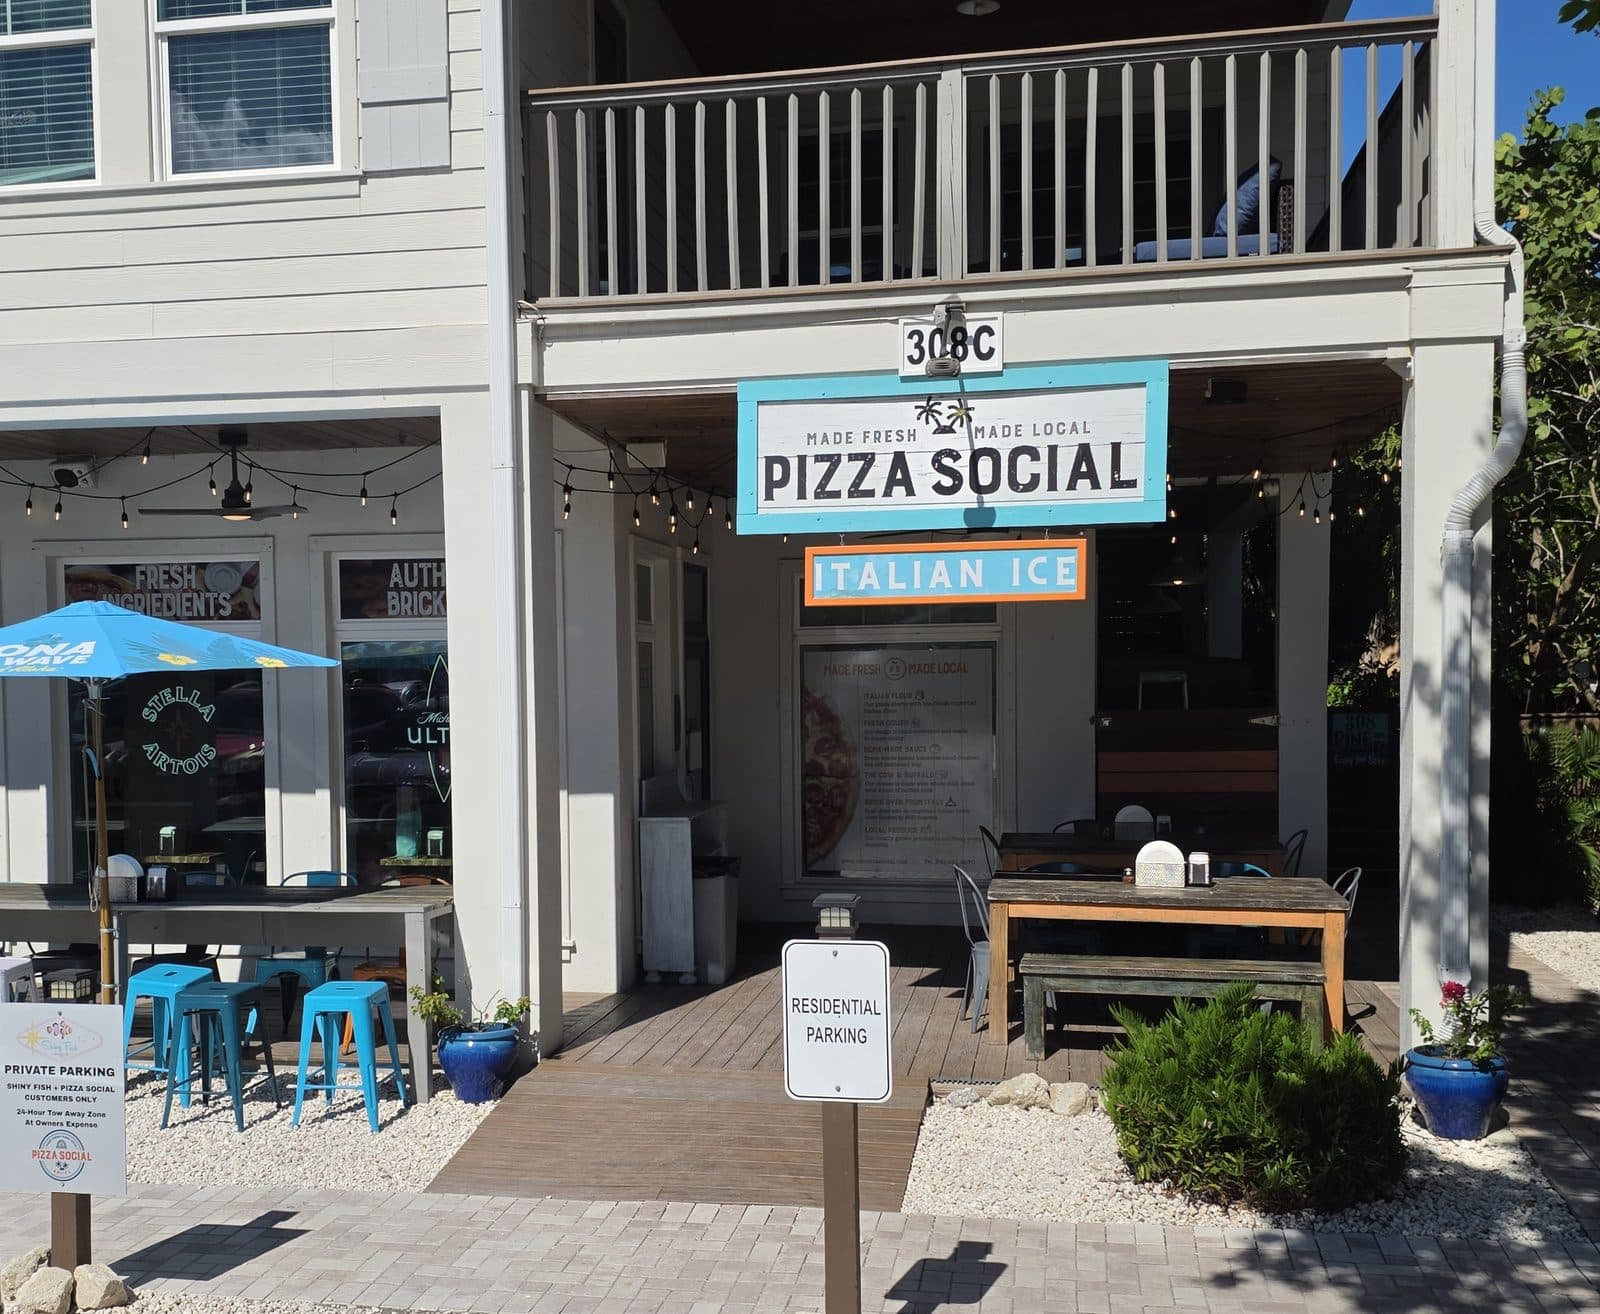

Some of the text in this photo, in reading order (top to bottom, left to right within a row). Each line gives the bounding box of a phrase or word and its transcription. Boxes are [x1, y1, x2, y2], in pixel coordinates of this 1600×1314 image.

[907, 325, 995, 365] 308C
[806, 420, 1091, 446] MADE FRESH MADE LOCAL
[763, 441, 1138, 501] PIZZA SOCIAL
[135, 563, 196, 590] FRESH
[389, 562, 445, 588] AUTH
[815, 555, 1076, 592] ITALIAN ICE
[387, 590, 446, 616] BRICK
[0, 640, 97, 658] ONA
[4, 654, 92, 666] WAVE
[823, 662, 968, 676] MADE FRESH MADE LOCAL
[142, 686, 217, 723] STELLA
[416, 711, 450, 725] Mich
[406, 727, 450, 744] ULT
[142, 741, 217, 776] ARTOIS
[792, 997, 881, 1015] RESIDENTIAL
[806, 1027, 868, 1044] PARKING
[4, 1064, 115, 1078] PRIVATE PARKING
[33, 1083, 52, 1091] FISH
[60, 1084, 84, 1092] PIZZA
[85, 1085, 116, 1093] SOCIAL
[24, 1094, 98, 1103] CUSTOMERS ONLY
[16, 1108, 106, 1119] 24-Hour Tow Away Zone
[35, 1119, 64, 1127] Owners
[66, 1121, 98, 1129] Expense
[32, 1149, 92, 1161] PIZZA SOCIAL
